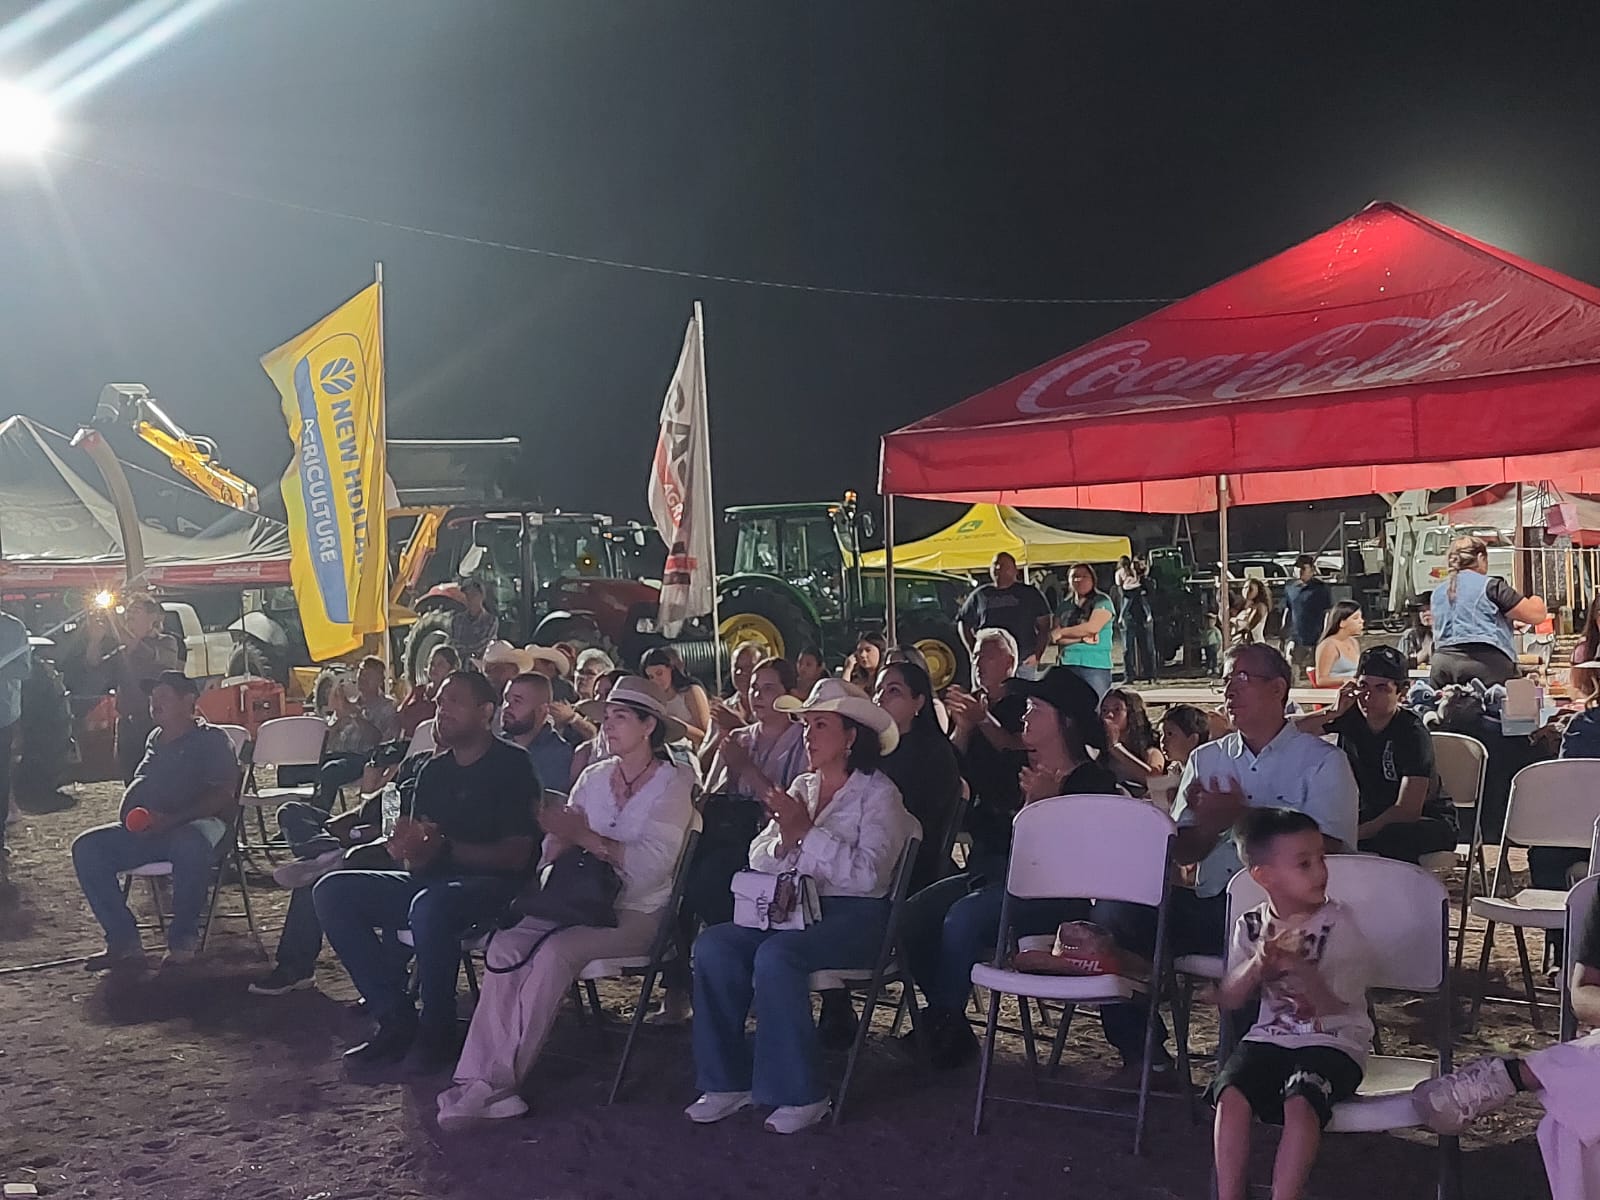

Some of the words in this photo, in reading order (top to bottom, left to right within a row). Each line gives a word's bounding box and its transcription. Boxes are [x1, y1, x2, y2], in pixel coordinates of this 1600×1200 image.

[1016, 291, 1510, 413] Coca-Cola
[331, 400, 359, 462] NEW
[344, 468, 367, 566] HOLLA
